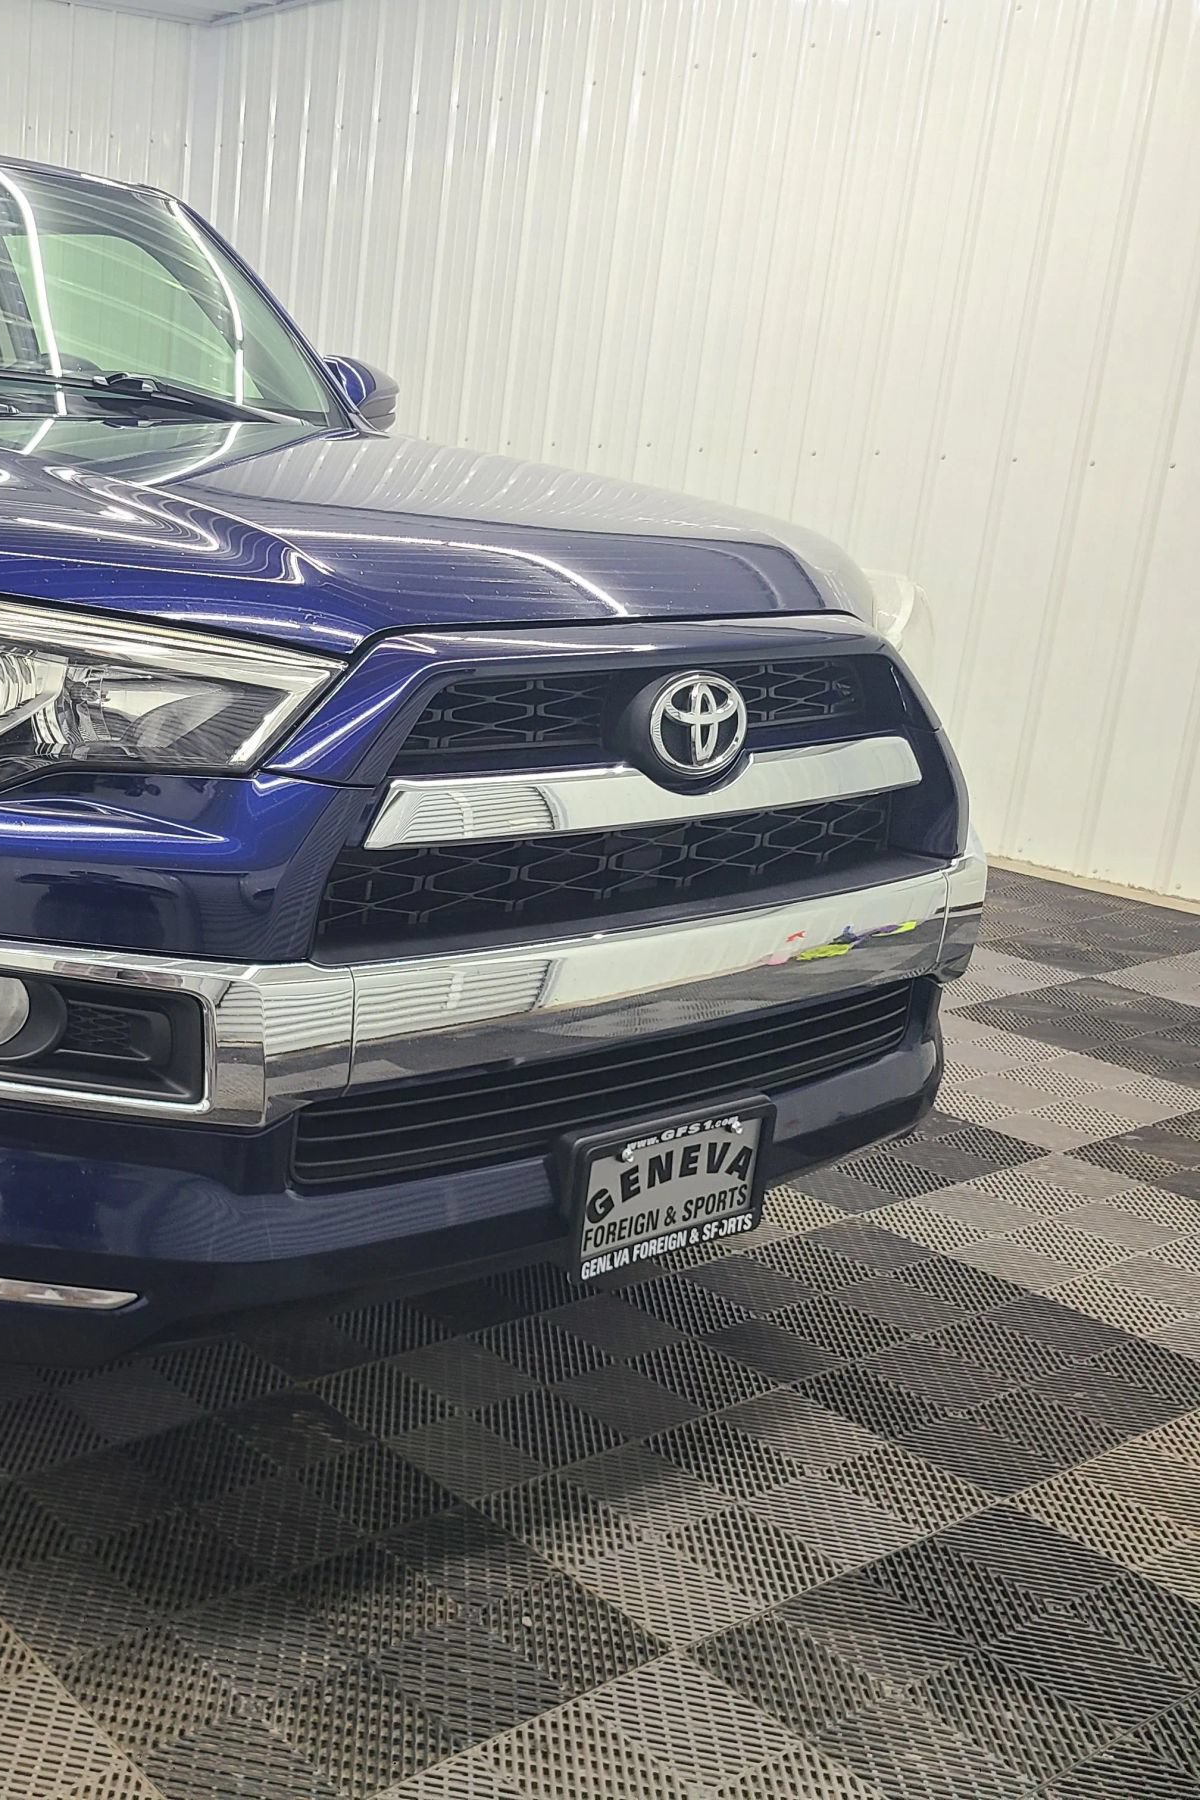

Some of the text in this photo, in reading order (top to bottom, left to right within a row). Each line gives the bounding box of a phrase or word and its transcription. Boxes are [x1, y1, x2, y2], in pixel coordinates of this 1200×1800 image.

[586, 1142, 753, 1224] GENEVA
[582, 1184, 748, 1252] FOREIGN & SPORTS
[632, 1232, 688, 1262] FOREIGN
[689, 1227, 700, 1245] &
